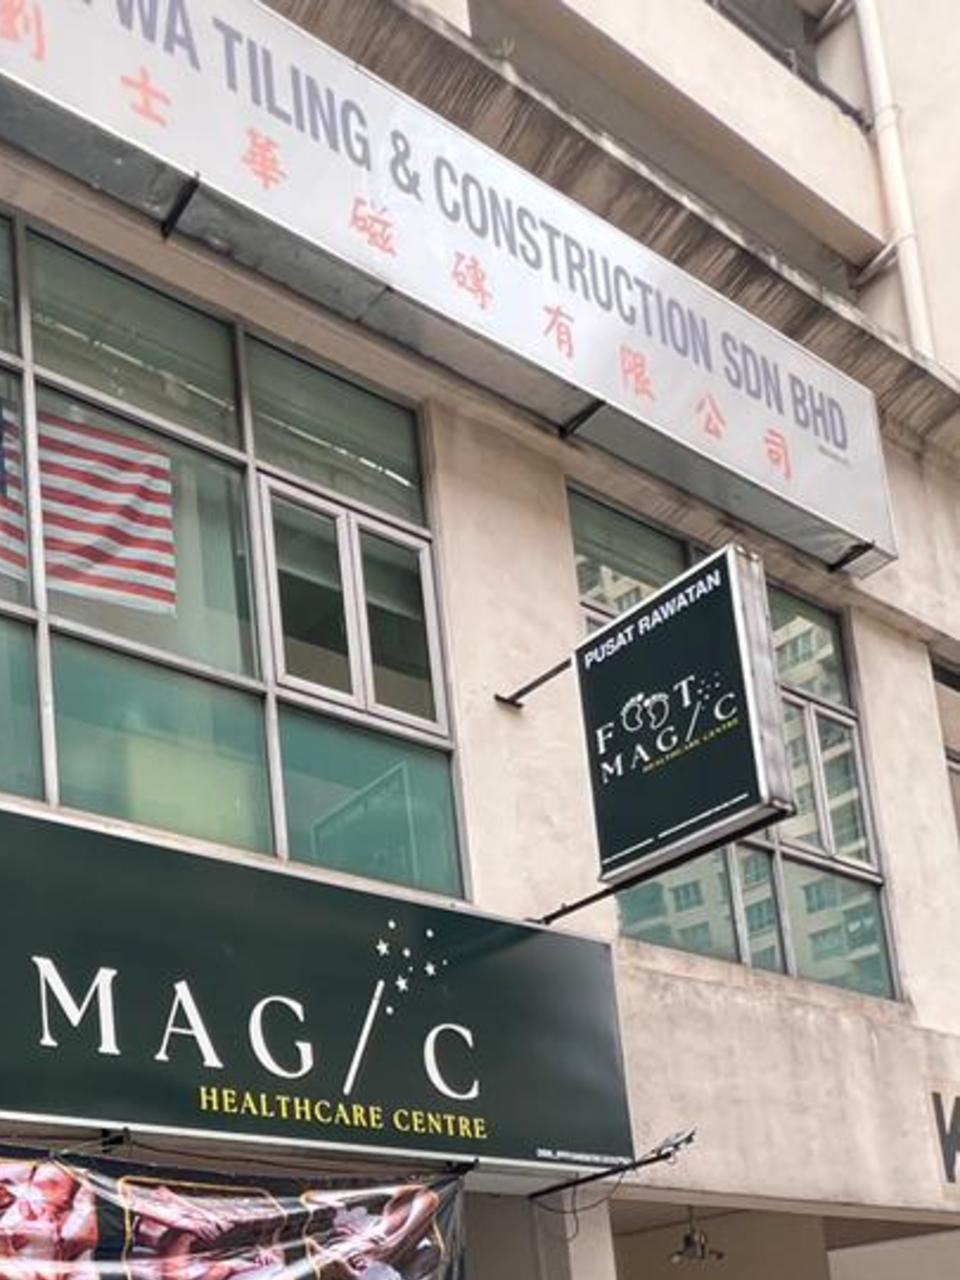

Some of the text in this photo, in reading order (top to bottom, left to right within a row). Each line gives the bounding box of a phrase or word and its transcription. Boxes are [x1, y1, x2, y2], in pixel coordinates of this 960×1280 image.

[212, 17, 371, 171] TILING
[389, 129, 423, 201] &
[433, 155, 713, 373] CONSTRUCTION
[720, 331, 784, 417] SDN
[790, 378, 848, 452] BHD
[583, 570, 722, 669] PUSAT RAWATAN
[198, 1086, 488, 1140] HEALTHCARE CENTRE
